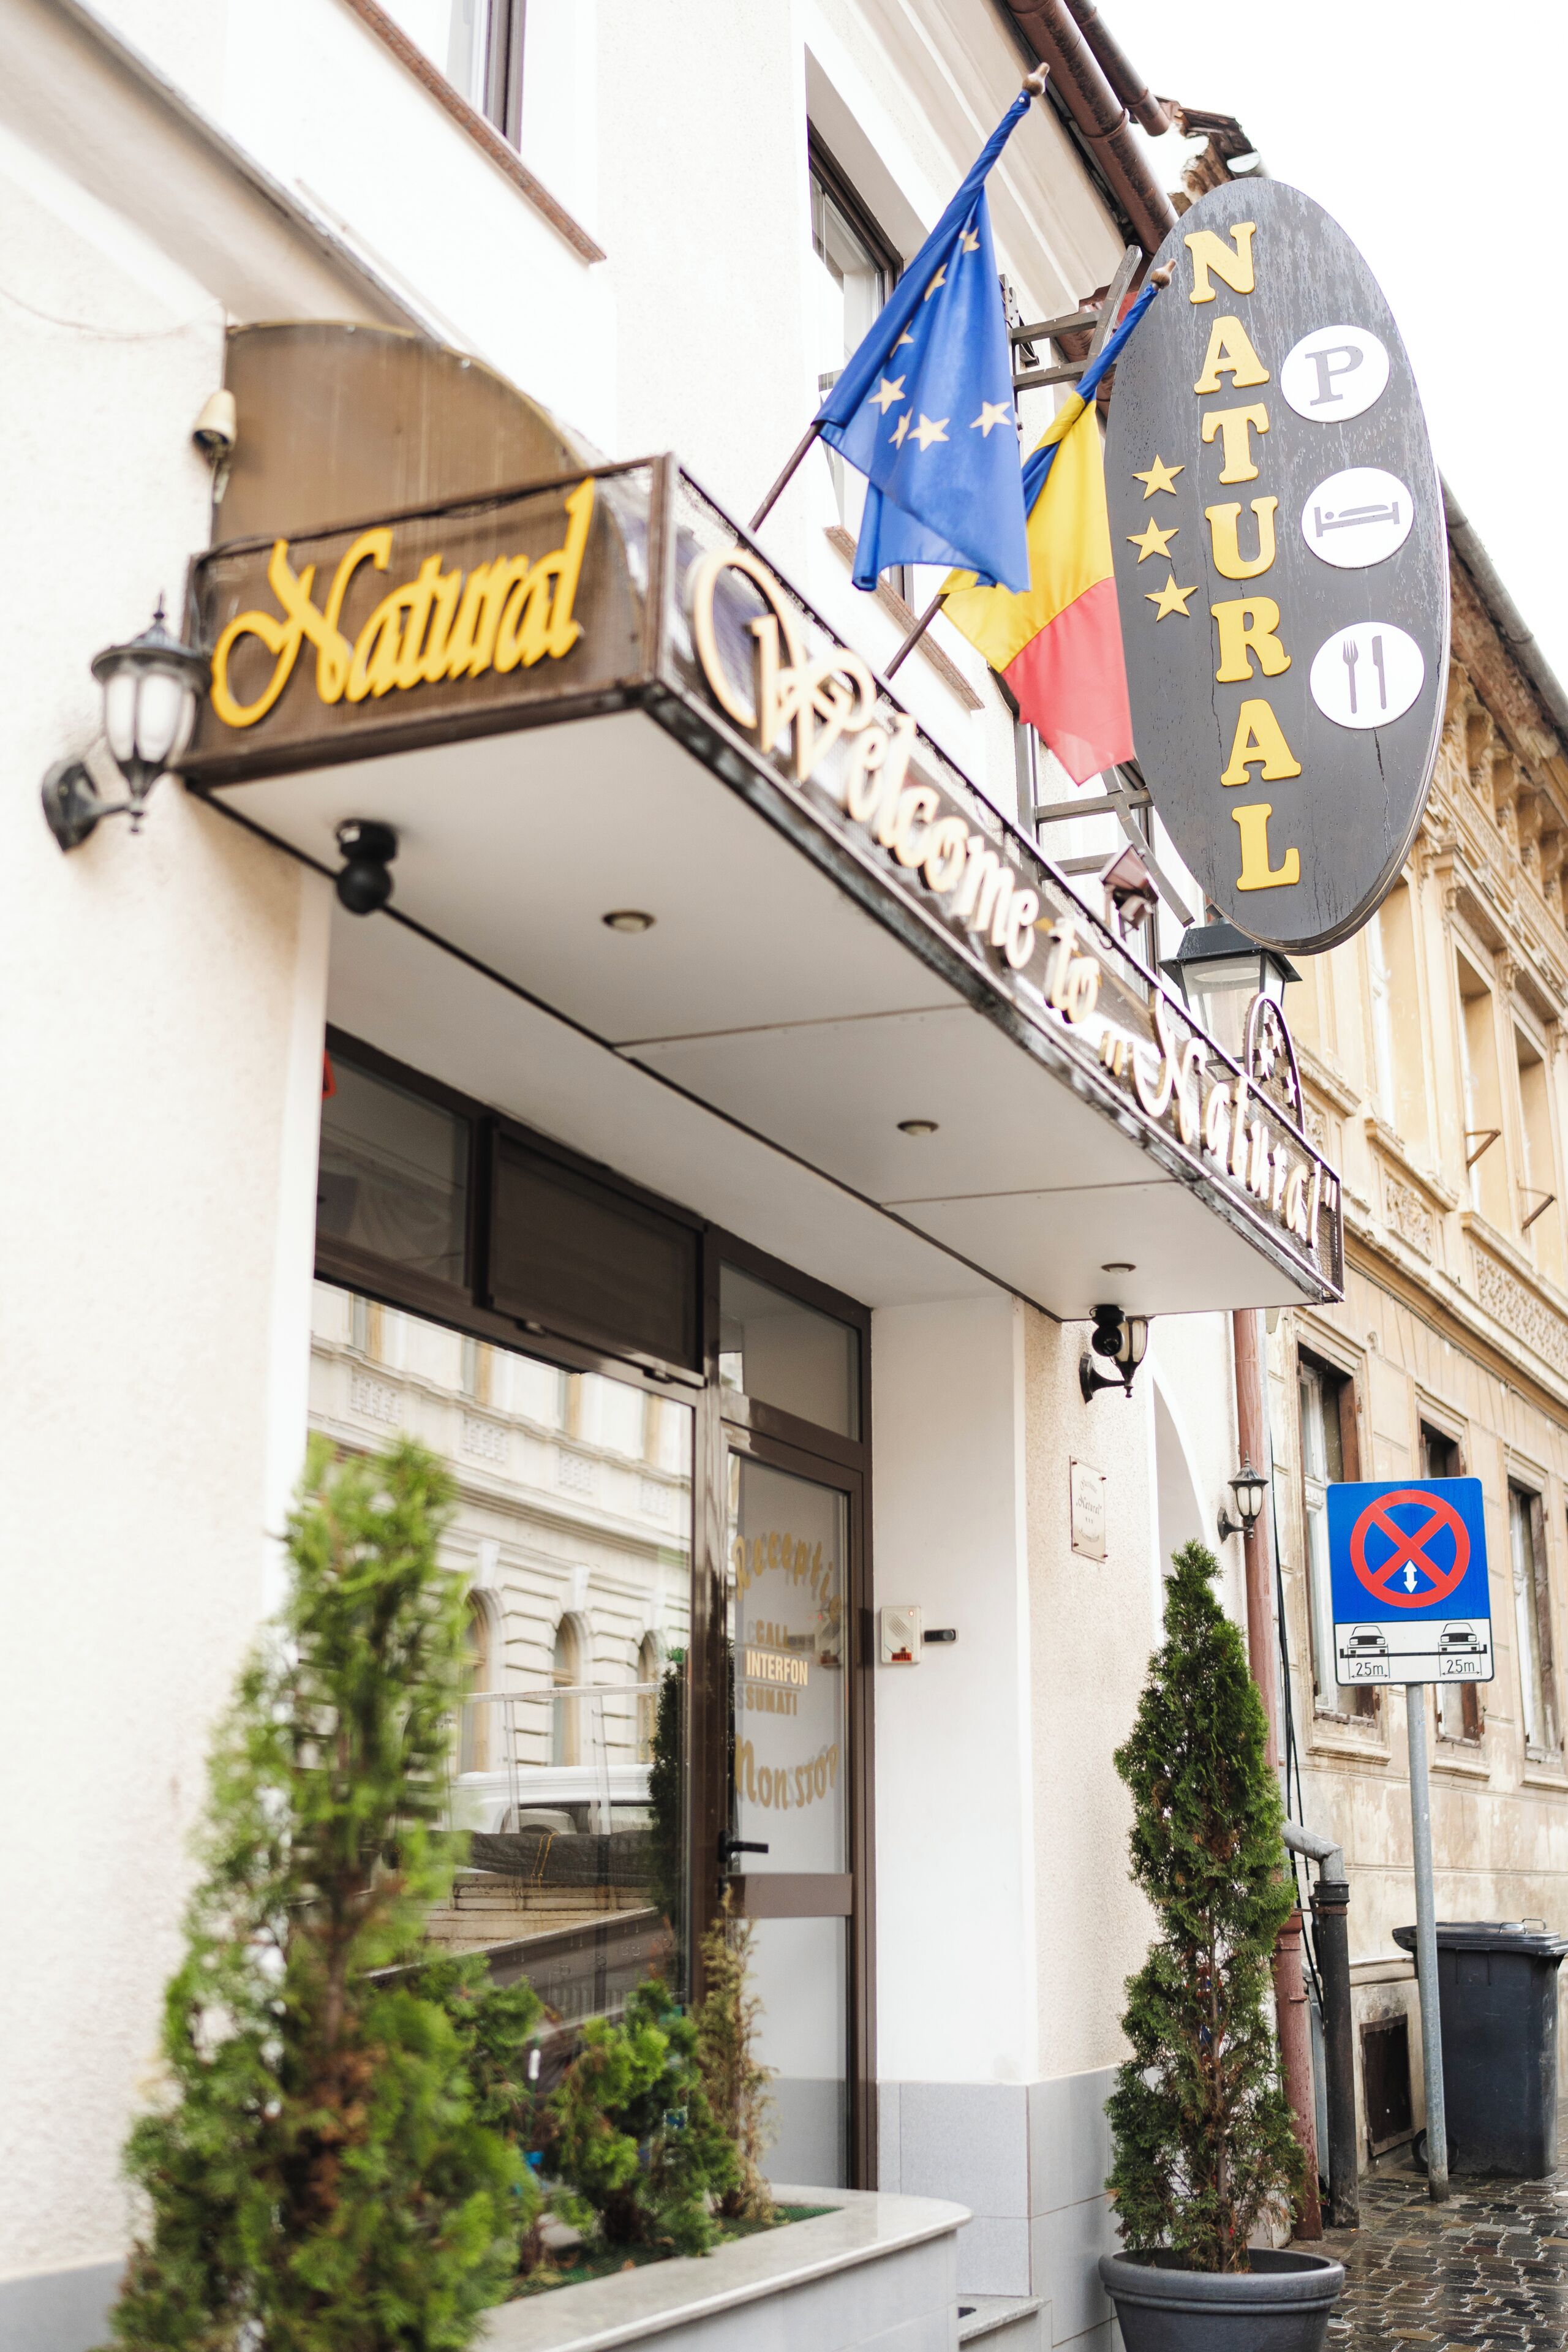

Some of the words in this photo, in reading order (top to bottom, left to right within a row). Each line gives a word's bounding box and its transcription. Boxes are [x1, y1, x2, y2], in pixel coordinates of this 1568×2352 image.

[1305, 345, 1364, 407] P
[1183, 221, 1302, 891] NATURAL
[211, 476, 596, 728] Natural
[692, 546, 1039, 969] Welcome
[1046, 917, 1099, 1025] to
[745, 1649, 809, 1686] INTERFON
[1355, 1662, 1384, 1676] 25m
[1446, 1659, 1475, 1673] 25m
